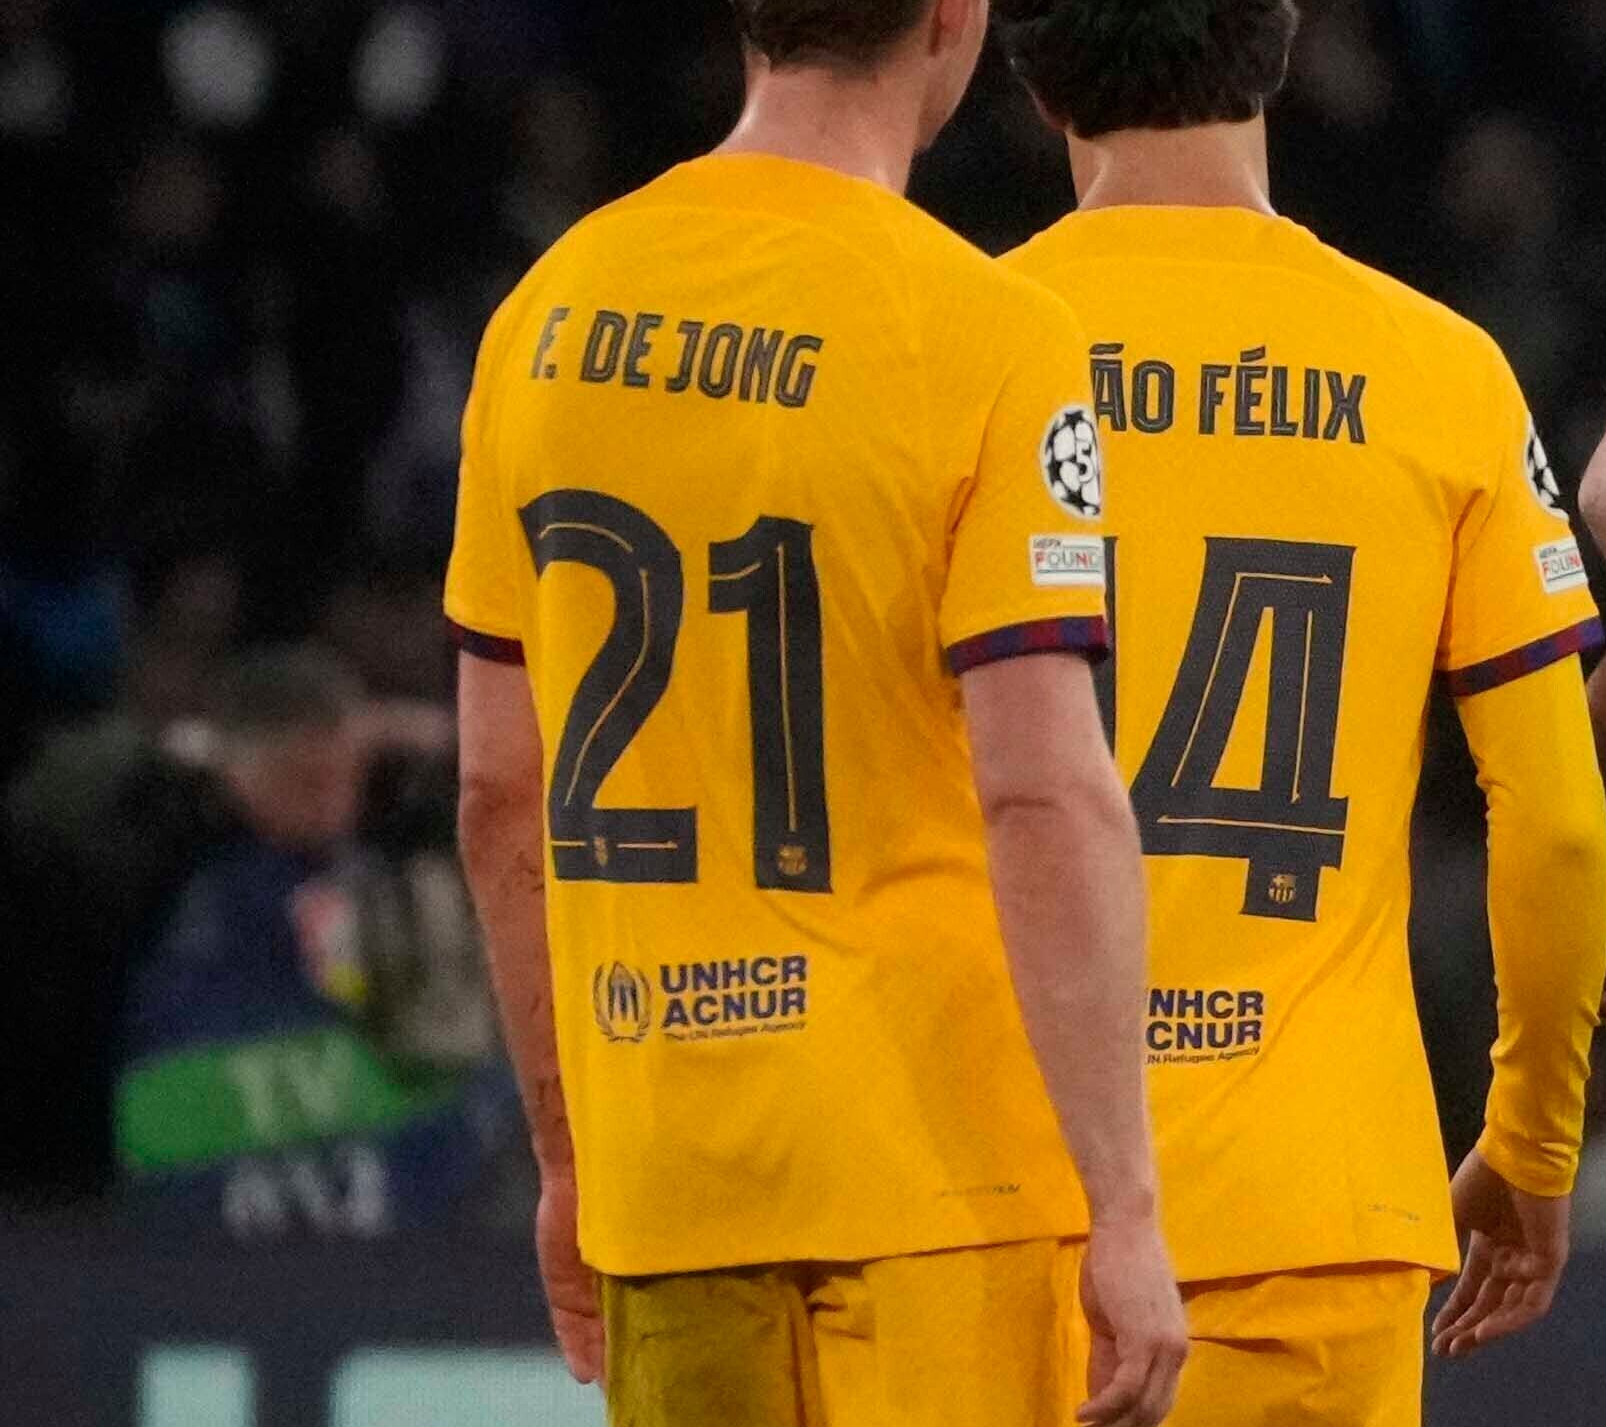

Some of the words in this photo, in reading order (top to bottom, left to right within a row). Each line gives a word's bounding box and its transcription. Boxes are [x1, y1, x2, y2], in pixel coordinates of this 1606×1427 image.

[530, 307, 570, 379] F.
[580, 310, 664, 388] DE
[664, 320, 824, 408] JONG
[1199, 344, 1367, 445] FÉLIX
[518, 488, 832, 894] 21
[660, 955, 808, 993] UNHCR
[660, 988, 808, 1028] ACNUR
